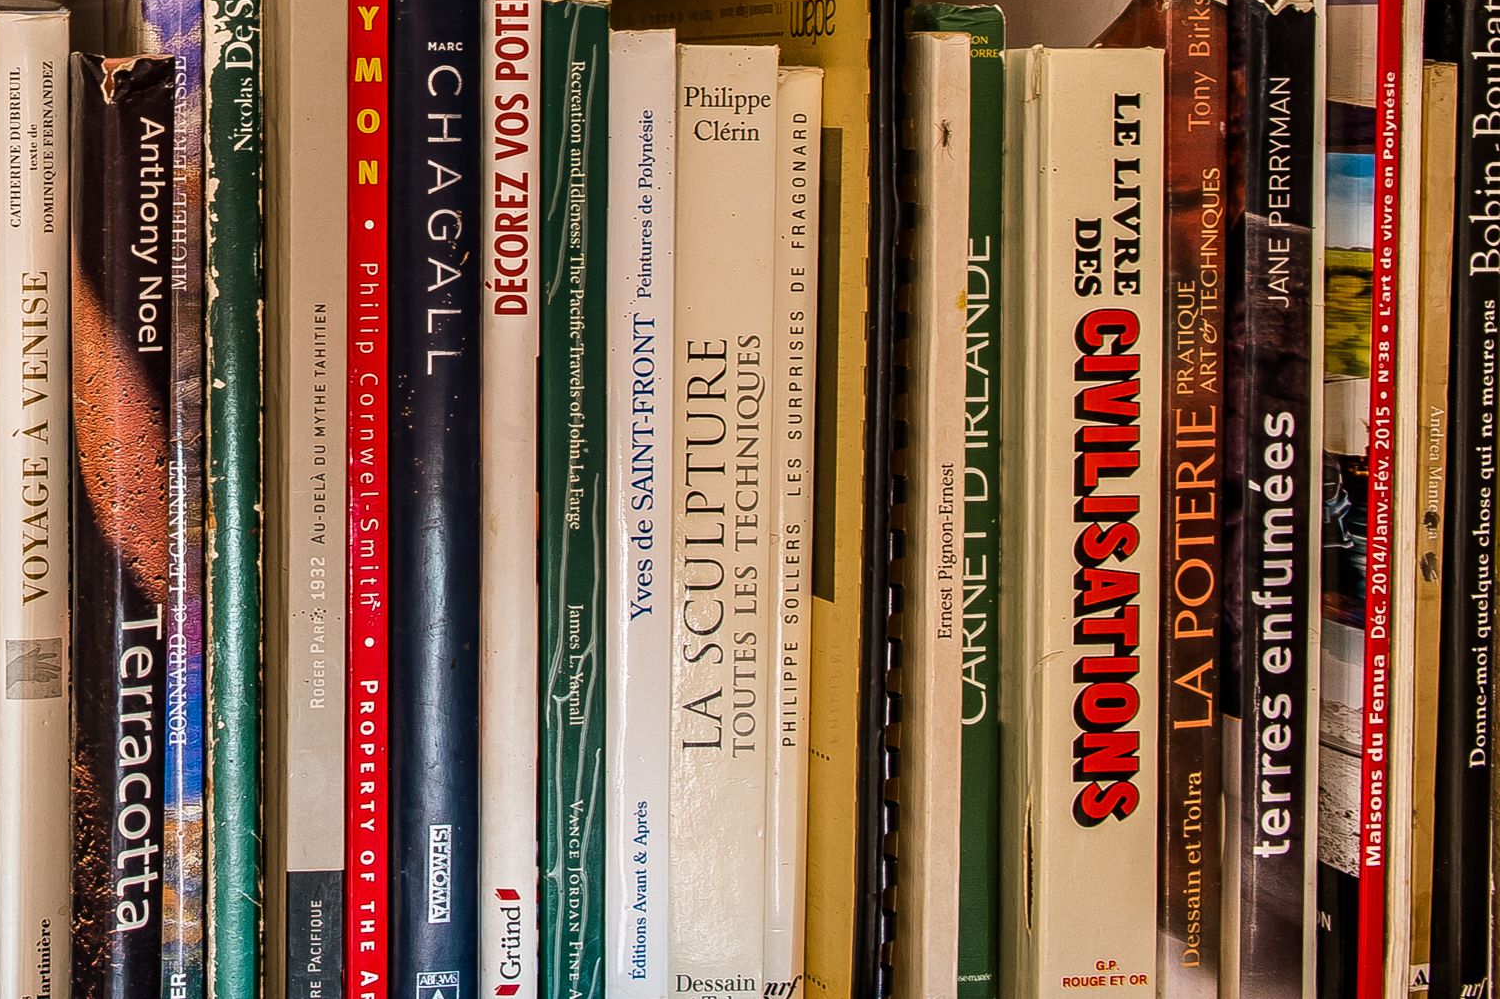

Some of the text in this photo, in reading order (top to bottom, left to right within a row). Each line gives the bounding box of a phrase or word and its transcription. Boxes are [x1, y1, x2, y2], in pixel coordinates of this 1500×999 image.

[227, 76, 255, 152] Nicolas
[427, 41, 463, 52] MARC
[684, 86, 772, 115] Philippe
[1187, 70, 1218, 133] Tony
[9, 66, 22, 229] CATHERINE DUBREUIL
[42, 60, 57, 235] DOMINIQUE FERNANDEZ
[131, 116, 166, 267] Anthony
[494, 92, 530, 162] VOS
[693, 120, 760, 142] Clérin
[1112, 92, 1142, 297] LE LIVRE
[1268, 76, 1292, 228] PERRYMAN
[427, 65, 463, 376] CHAGALL
[1073, 217, 1103, 298] DES
[1199, 166, 1222, 394] ART TECHNIQUES
[565, 60, 587, 531] Recreation Farge
[629, 109, 657, 621] Yves SAINT-FRONT Peintures Polynésie
[1176, 279, 1198, 395] PRATIQUE
[21, 270, 51, 607] VOYAGE VENISE
[313, 302, 328, 439] MYTHE TAHITIEN
[781, 111, 808, 748] PHILIPPE SOLLERS LES SURPRISES FRAGONARD
[1429, 405, 1446, 462] Andrea
[1473, 339, 1496, 551] chose meure
[681, 338, 729, 752] LA SCULPTURE
[732, 333, 766, 759] TOUTES LES TECHNIQUES
[937, 594, 954, 640] Ernest
[1071, 306, 1142, 829] CIVILISATIONS
[1173, 404, 1217, 731] LA POTERIE
[168, 632, 188, 747] BONNARD
[569, 672, 584, 727] Yarnall
[1247, 411, 1295, 859] terres enfumées
[1365, 405, 1391, 867] Maisons Fenua 2015
[115, 602, 162, 933] Terracotta
[359, 679, 379, 833] PROPERTY
[1183, 771, 1203, 842] Tolra
[306, 898, 323, 974] PACIFIQUE
[498, 904, 522, 981] Gründ
[566, 863, 583, 933] JORDAN
[1095, 960, 1120, 971] G.P.
[675, 973, 756, 993] Dessain
[1062, 976, 1107, 988] ROUGE
